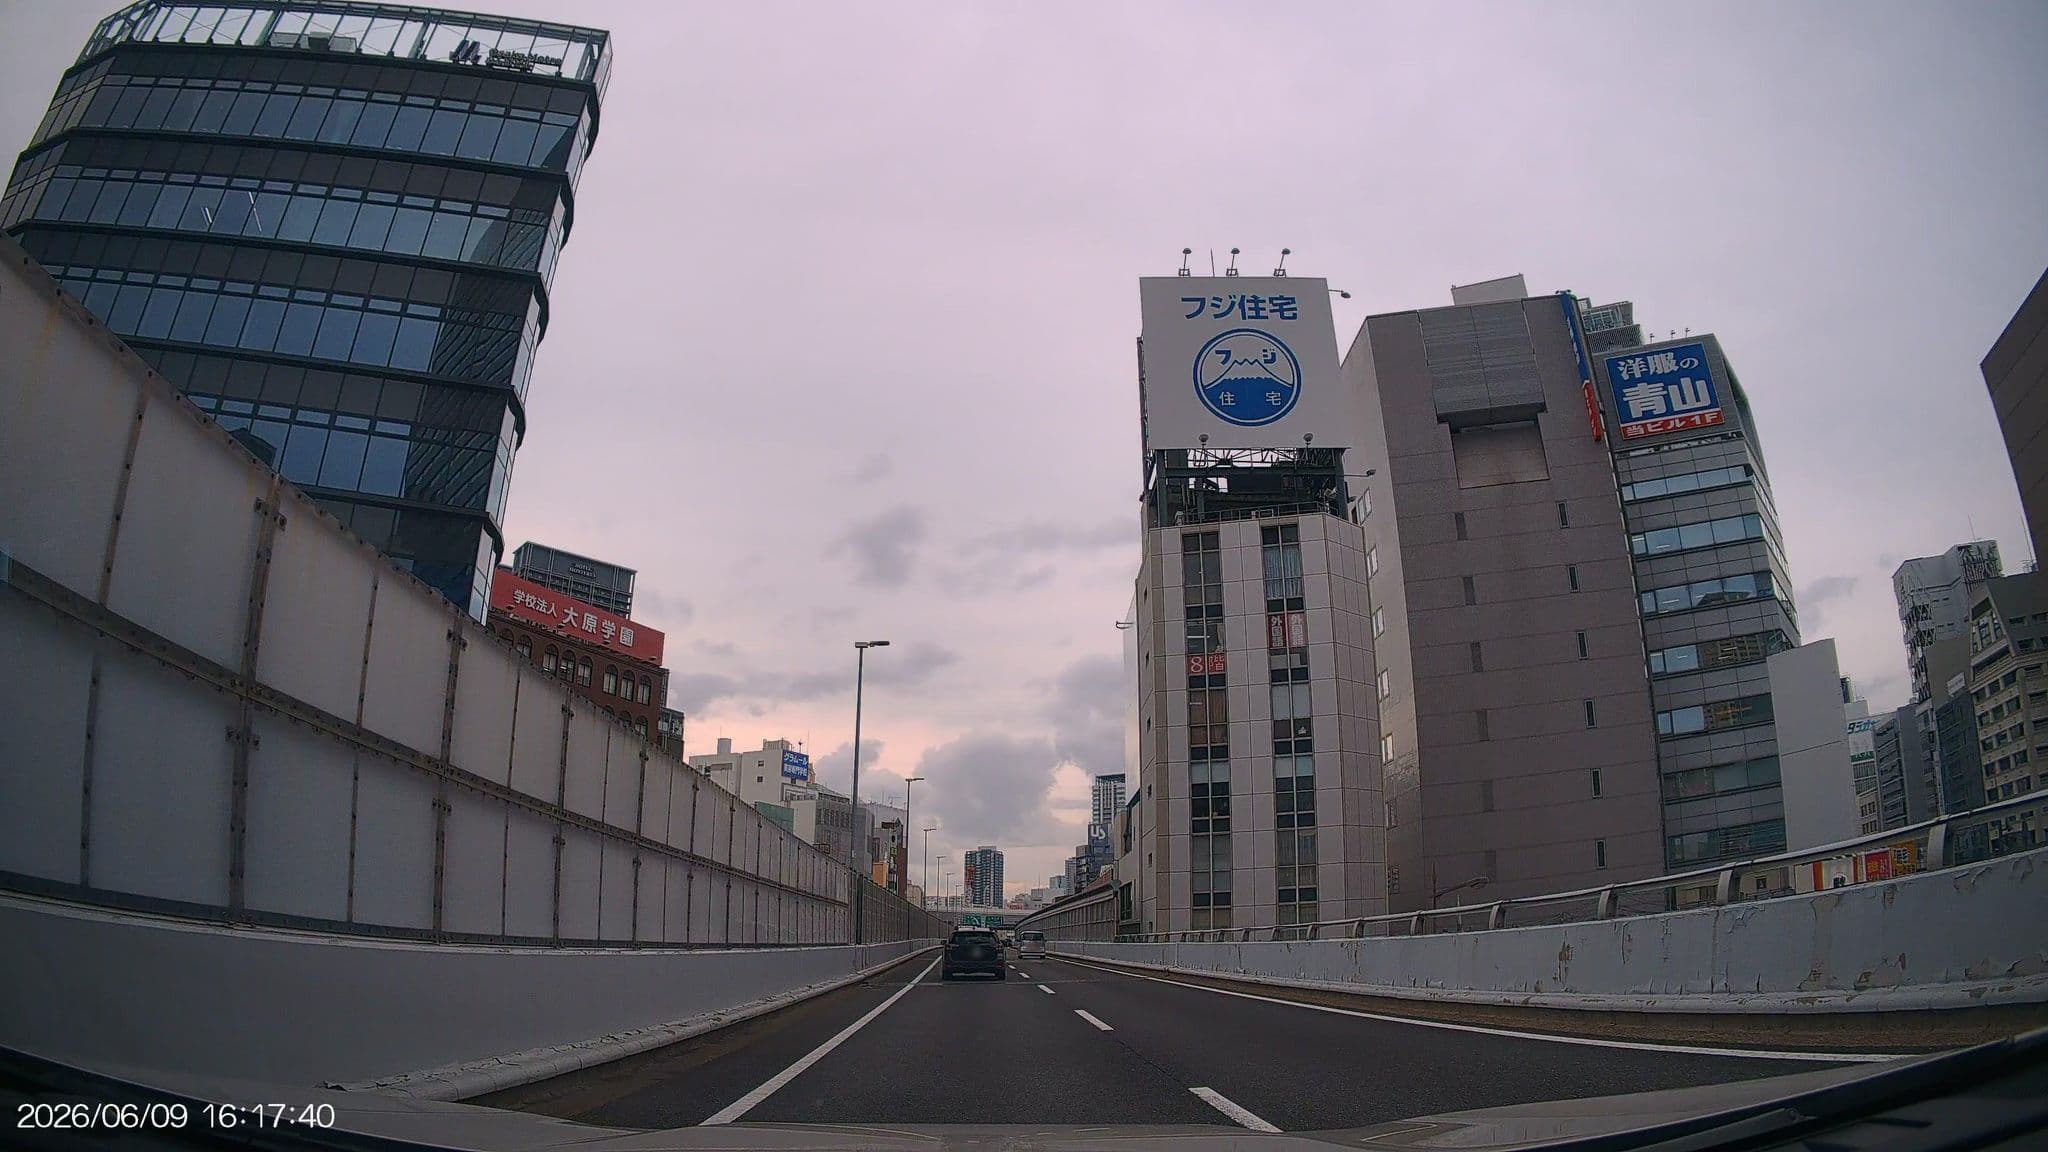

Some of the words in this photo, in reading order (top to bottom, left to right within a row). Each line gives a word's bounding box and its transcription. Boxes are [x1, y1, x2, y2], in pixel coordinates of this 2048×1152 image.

[1181, 294, 1298, 321] フジ住宅
[1617, 352, 1699, 380] 洋服の
[1622, 377, 1711, 418] 青山
[1626, 413, 1719, 437] 当ビル1F
[513, 589, 558, 618] 学校法人
[563, 606, 634, 647] 大原学園
